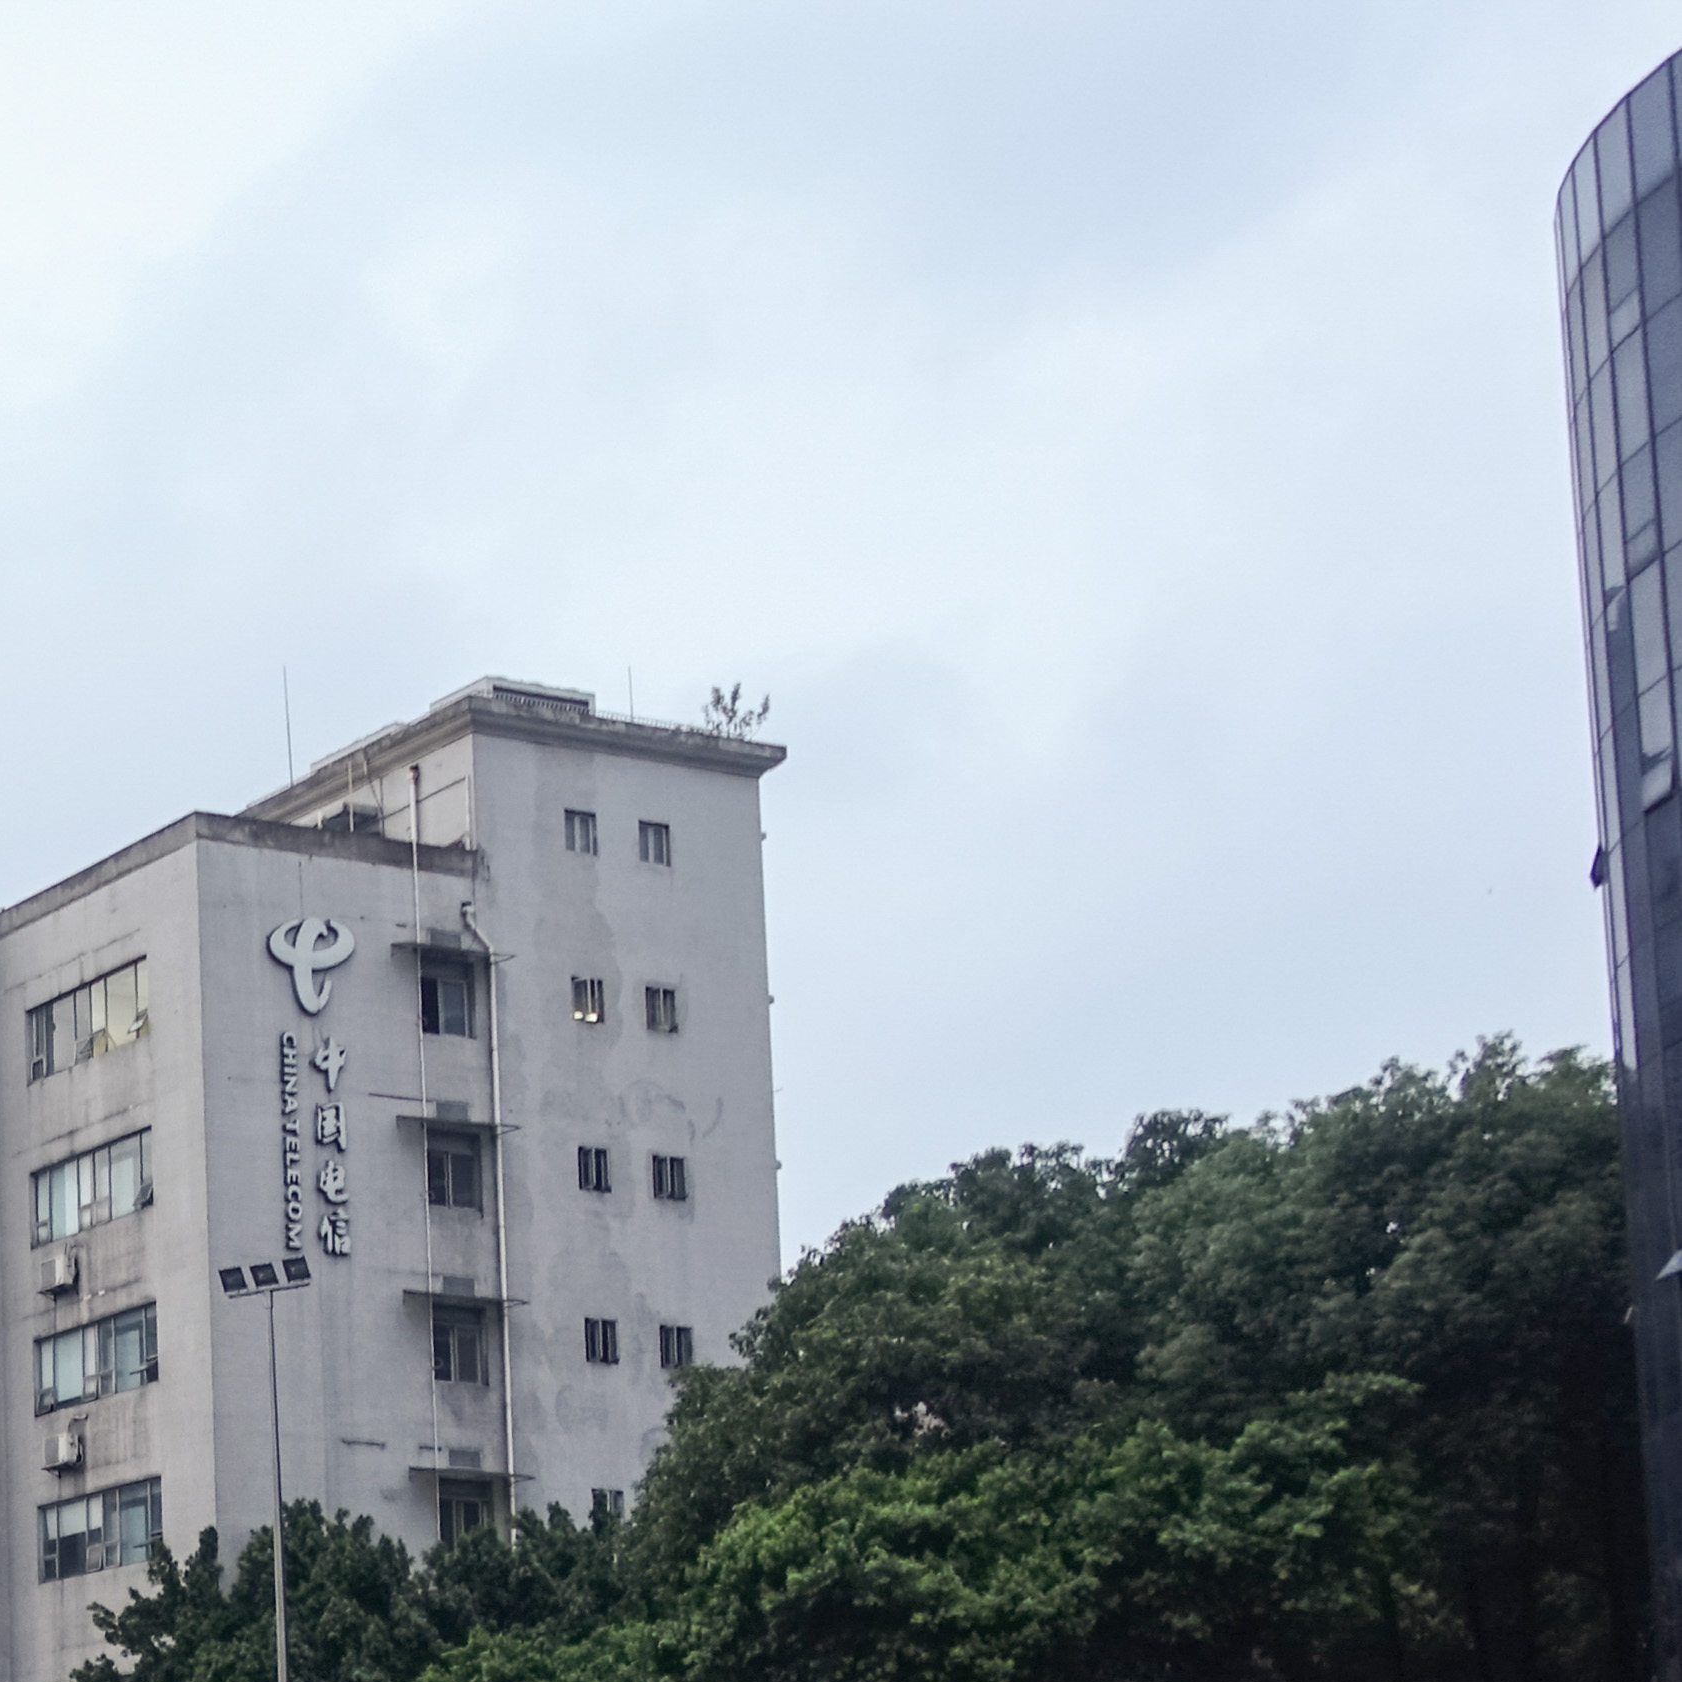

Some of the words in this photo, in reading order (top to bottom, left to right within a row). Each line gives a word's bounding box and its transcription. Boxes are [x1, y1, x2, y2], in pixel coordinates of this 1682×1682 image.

[280, 1030, 299, 1115] CHINA
[282, 1119, 304, 1250] TELECOM
[312, 1036, 350, 1256] 中国电信
